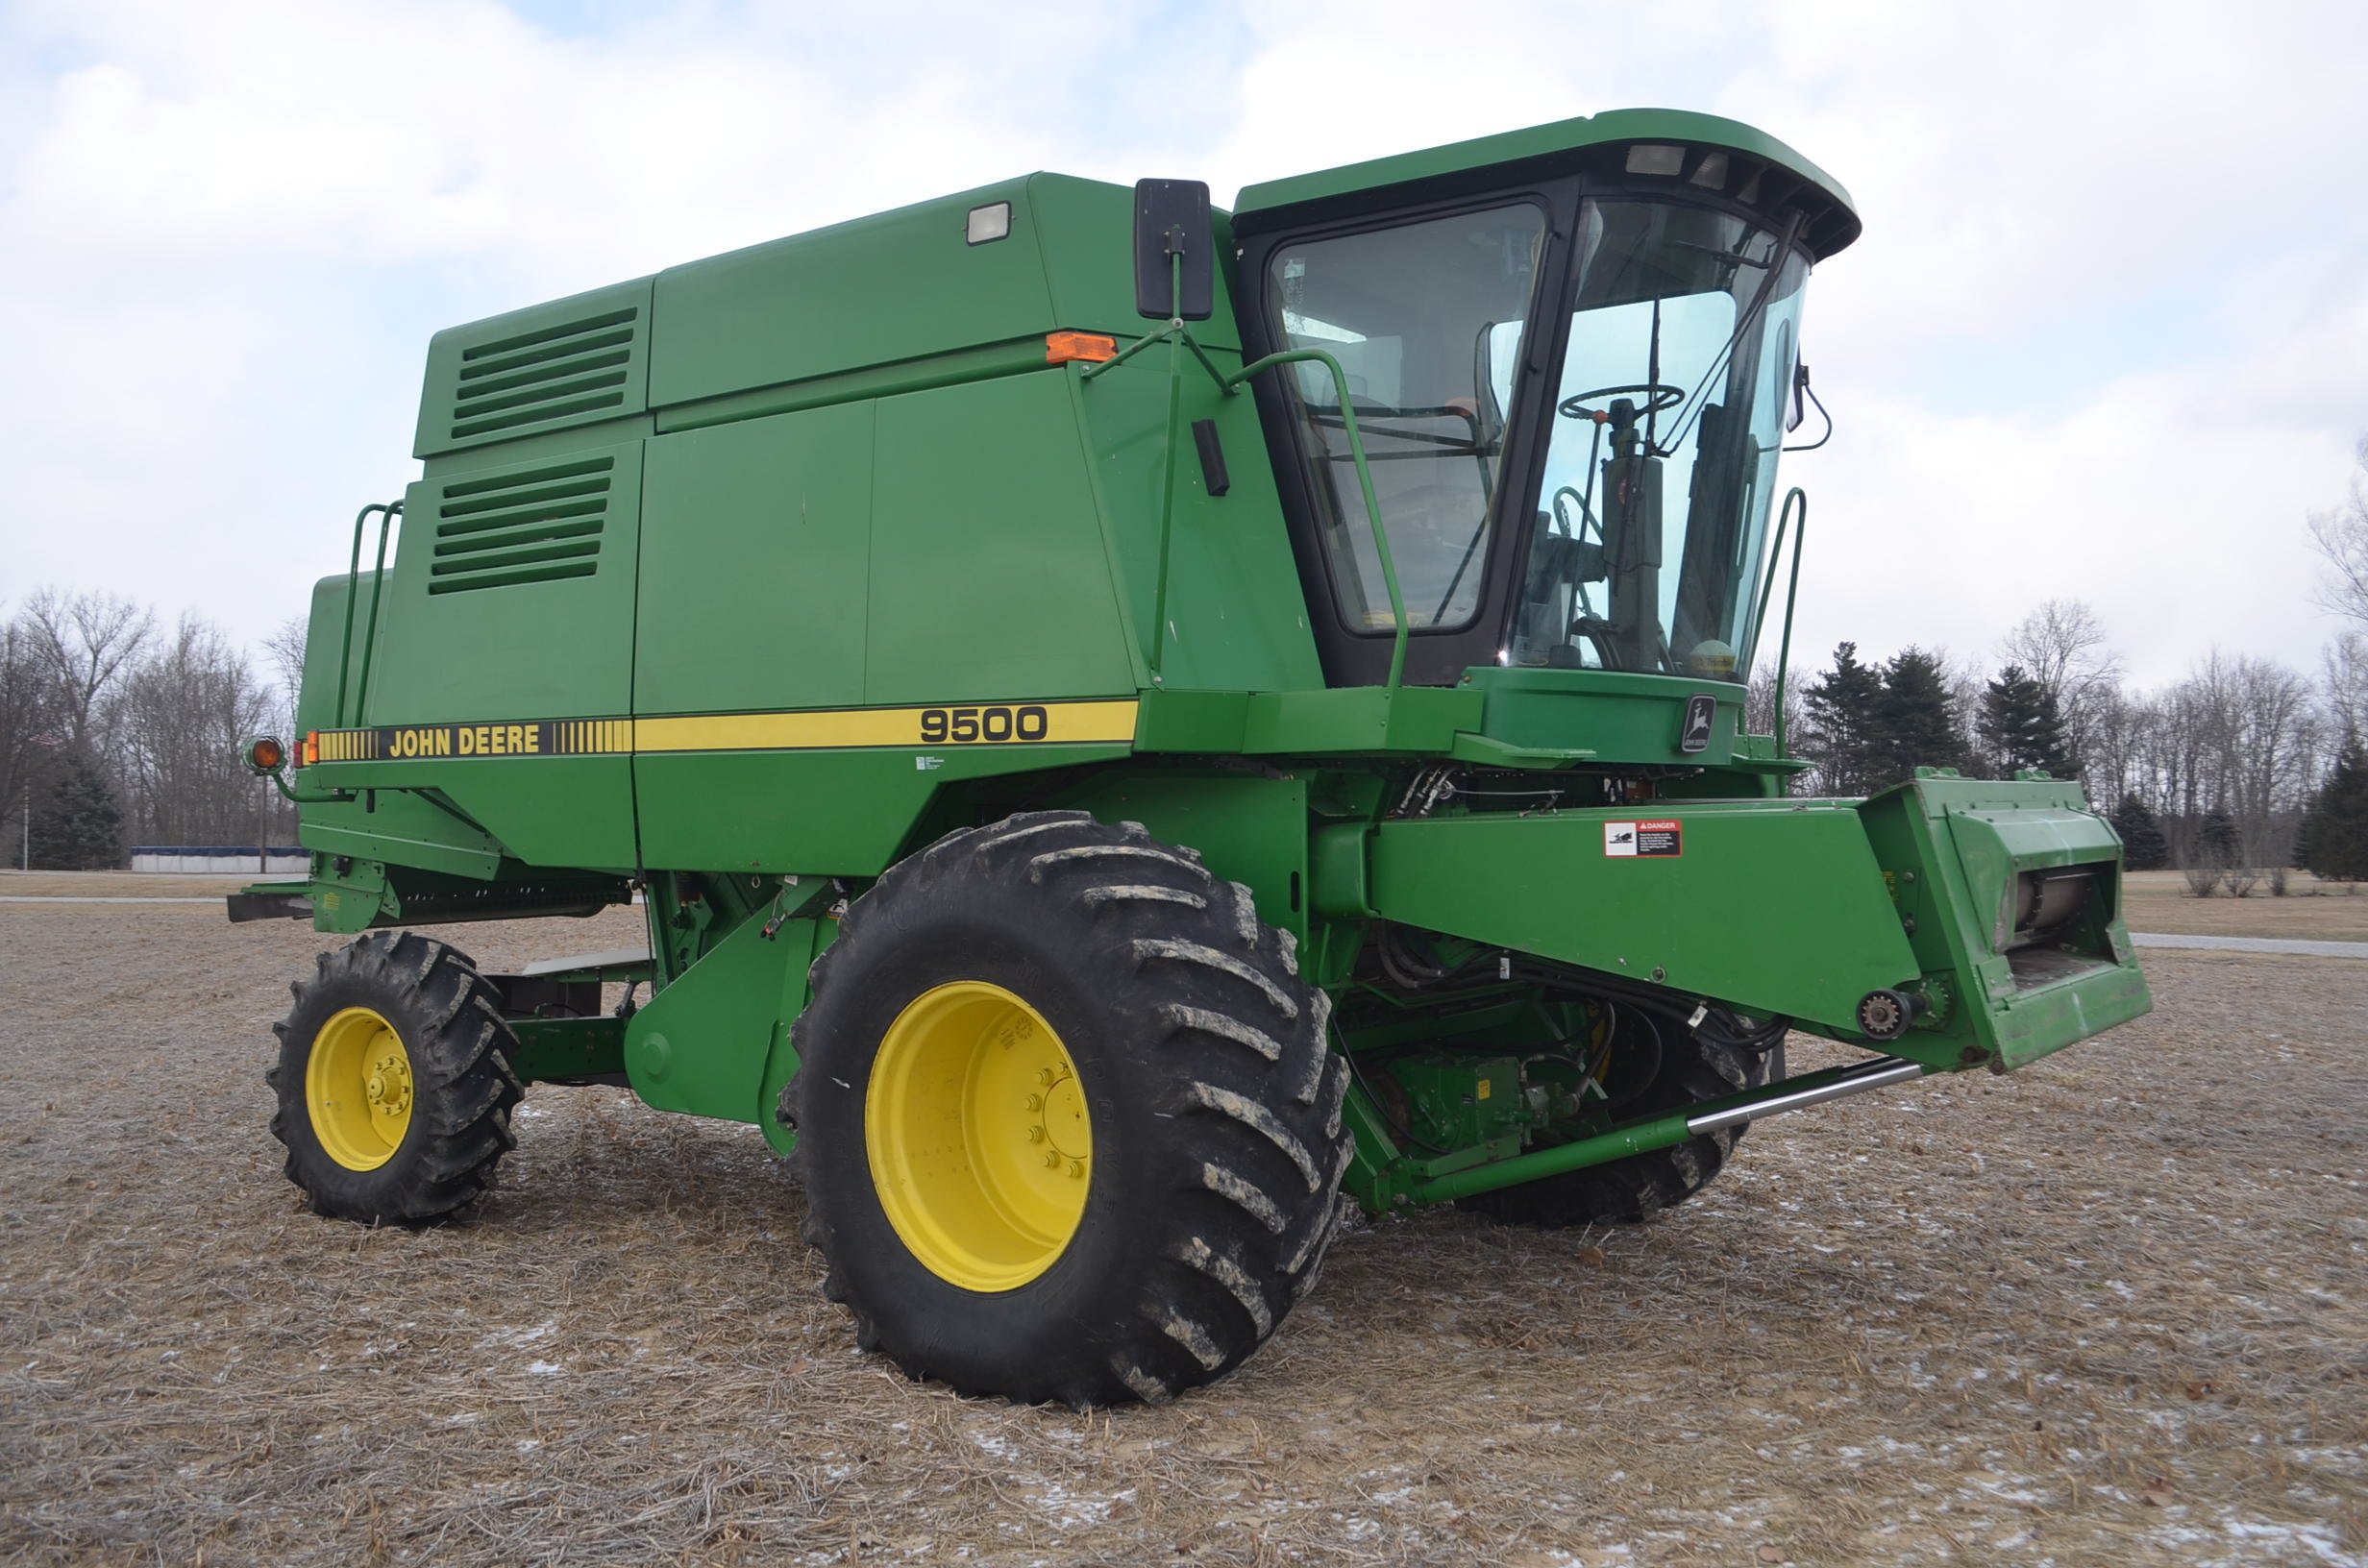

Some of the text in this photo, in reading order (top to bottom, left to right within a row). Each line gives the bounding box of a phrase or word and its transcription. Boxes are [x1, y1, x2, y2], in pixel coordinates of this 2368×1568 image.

[389, 724, 539, 757] JOHN DEERE
[921, 706, 1048, 743] 9500
